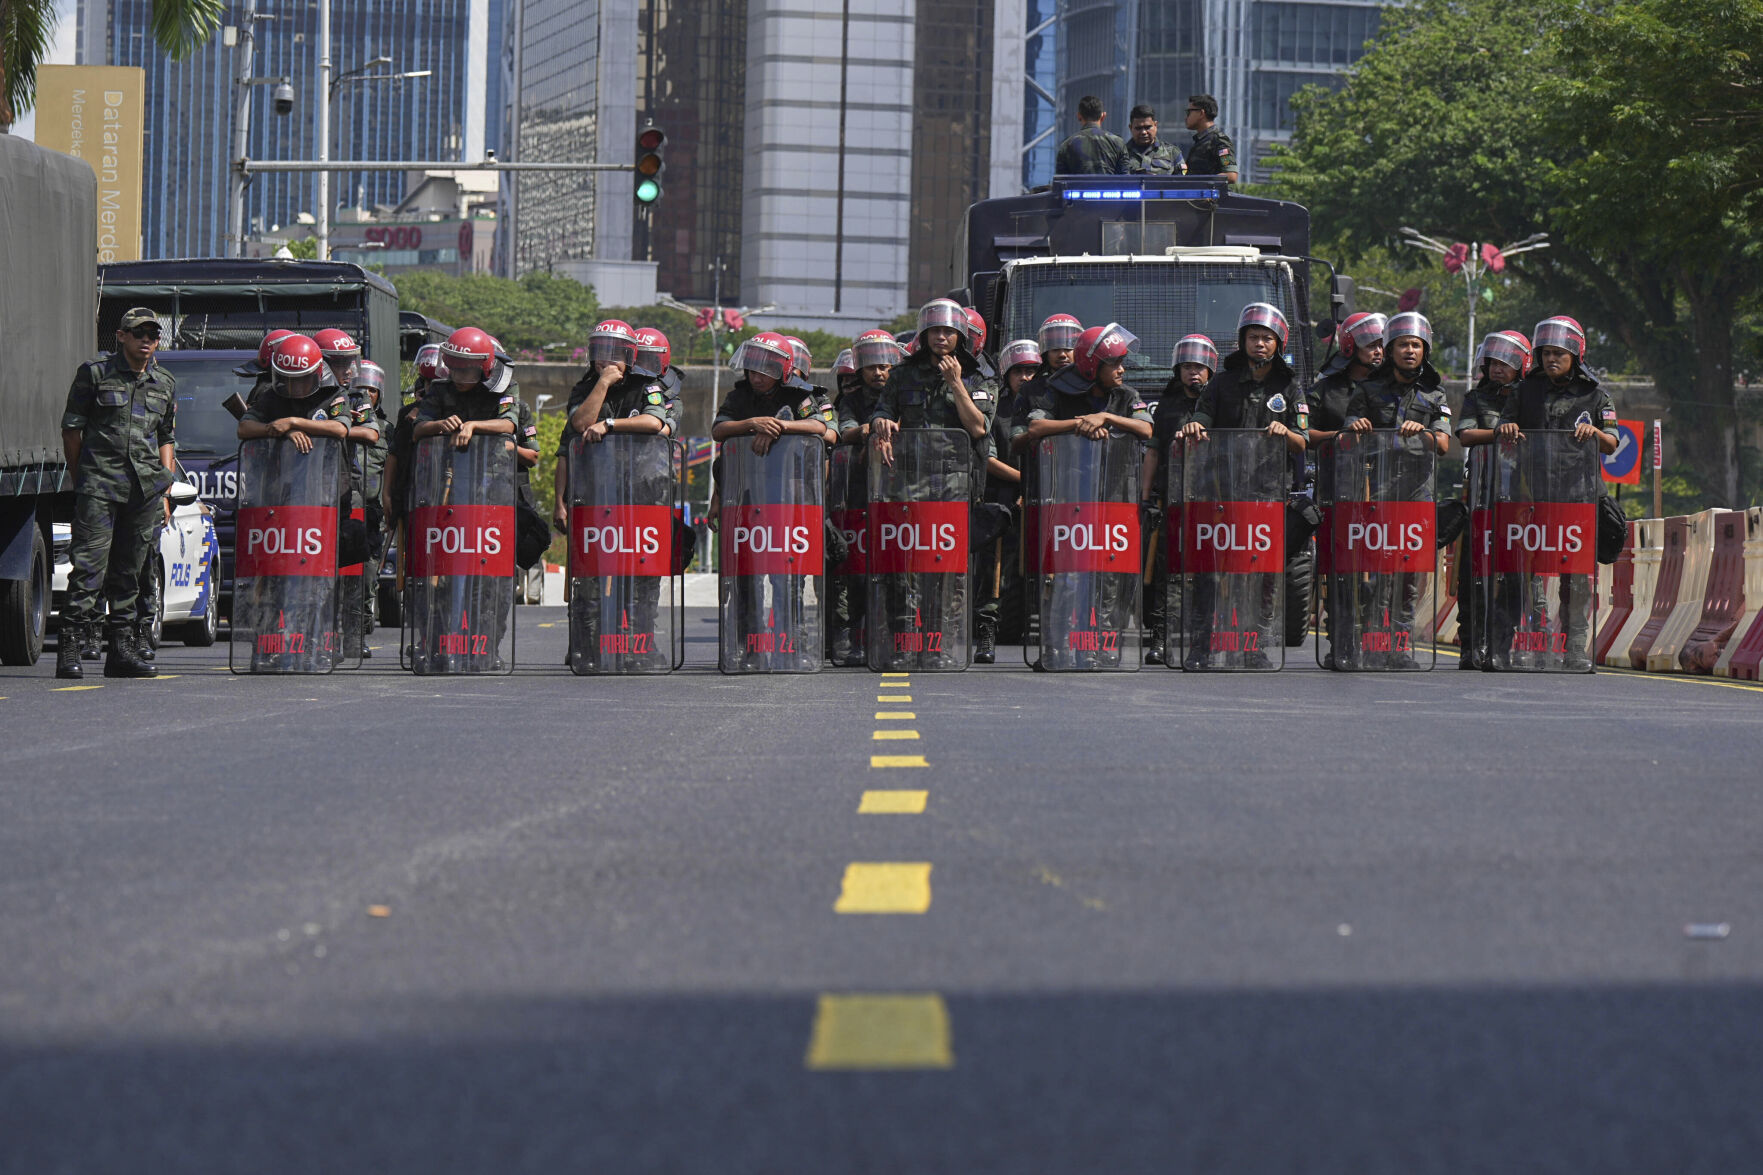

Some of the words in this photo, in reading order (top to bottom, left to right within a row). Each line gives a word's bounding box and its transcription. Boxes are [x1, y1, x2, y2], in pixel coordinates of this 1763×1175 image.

[102, 90, 124, 182] Dataran
[99, 190, 121, 263] Merde
[277, 353, 309, 370] POLIS
[185, 470, 238, 499] OLIS
[248, 527, 322, 555] POLIS
[426, 527, 501, 554] POLIS
[583, 526, 659, 554] POLIS
[733, 526, 809, 554] POLIS
[881, 523, 956, 551] POLIS
[1054, 523, 1129, 552] POLIS
[1196, 523, 1272, 551] POLIS
[1348, 523, 1423, 551] POLIS
[1506, 523, 1582, 552] POLIS
[278, 609, 285, 629] A
[461, 609, 469, 630] A
[621, 609, 629, 629] A
[768, 607, 775, 628] A
[914, 607, 922, 628] A
[1090, 607, 1097, 627] A
[1231, 607, 1239, 627] A
[1383, 607, 1390, 628] A
[289, 633, 304, 653] 22
[471, 634, 488, 655] 22
[927, 632, 942, 652] 22
[1102, 631, 1118, 651] 22
[1243, 631, 1259, 652] 22
[1395, 631, 1410, 652] 22
[1552, 632, 1568, 653] 22
